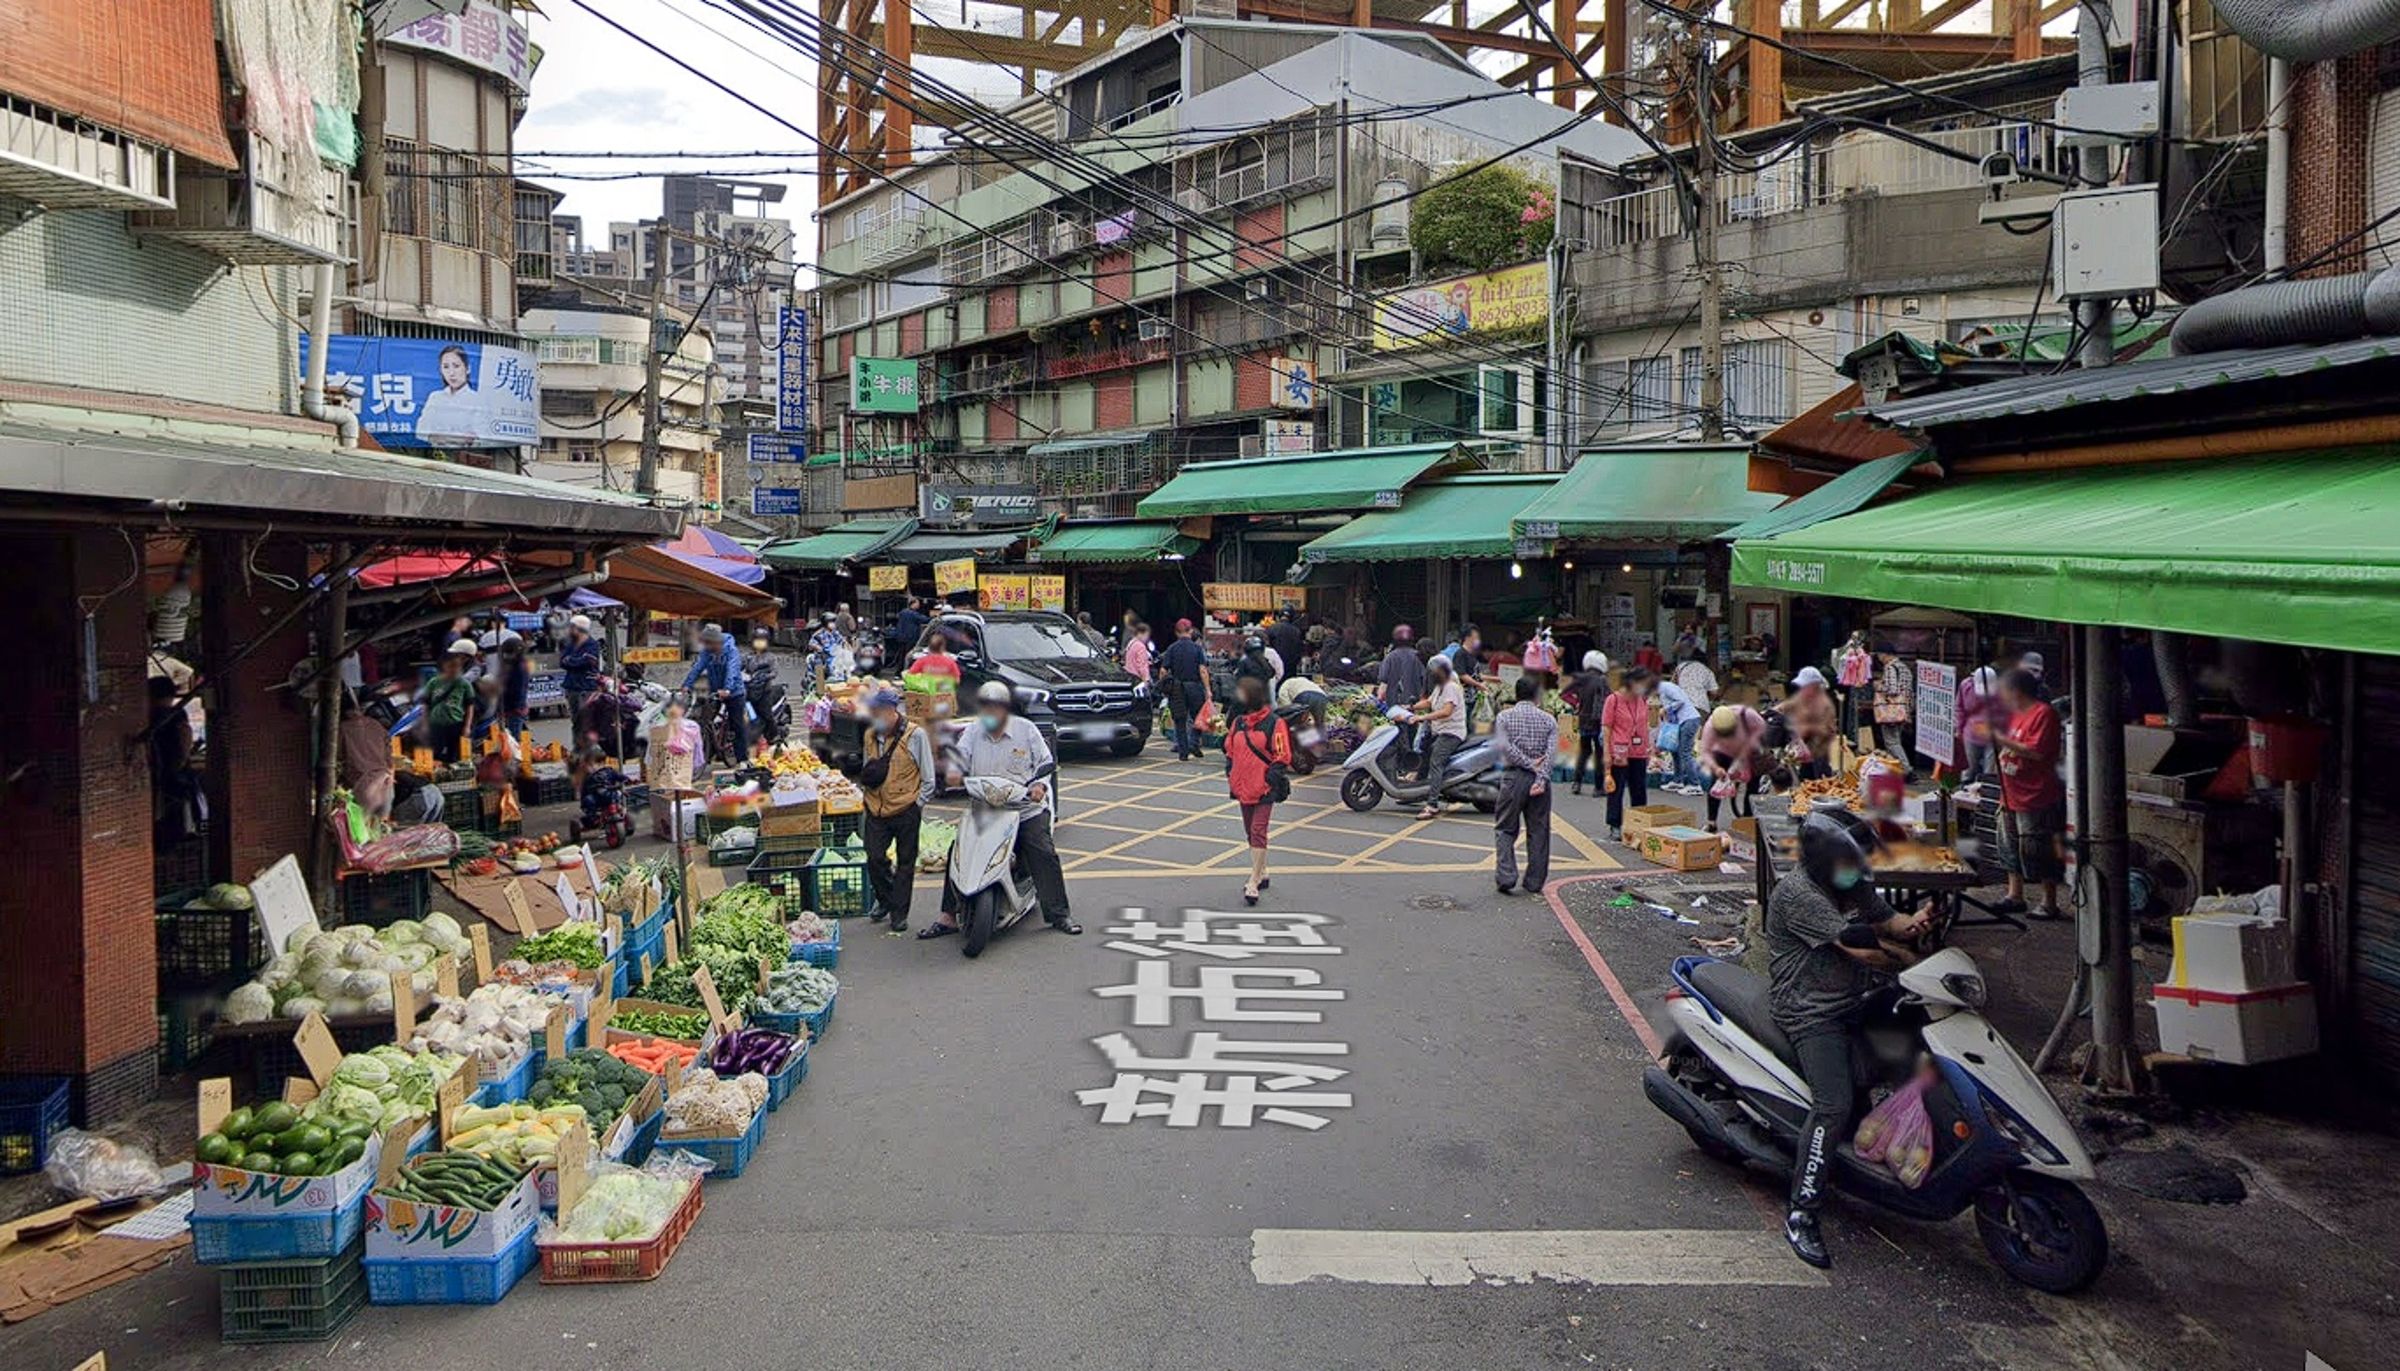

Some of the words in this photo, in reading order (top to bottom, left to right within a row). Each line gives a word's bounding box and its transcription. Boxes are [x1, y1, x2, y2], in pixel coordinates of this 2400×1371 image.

[493, 355, 535, 402] 勇敢
[873, 373, 914, 396] 牛排
[1284, 364, 1313, 405] 安
[1073, 906, 1353, 1131] 新市街
